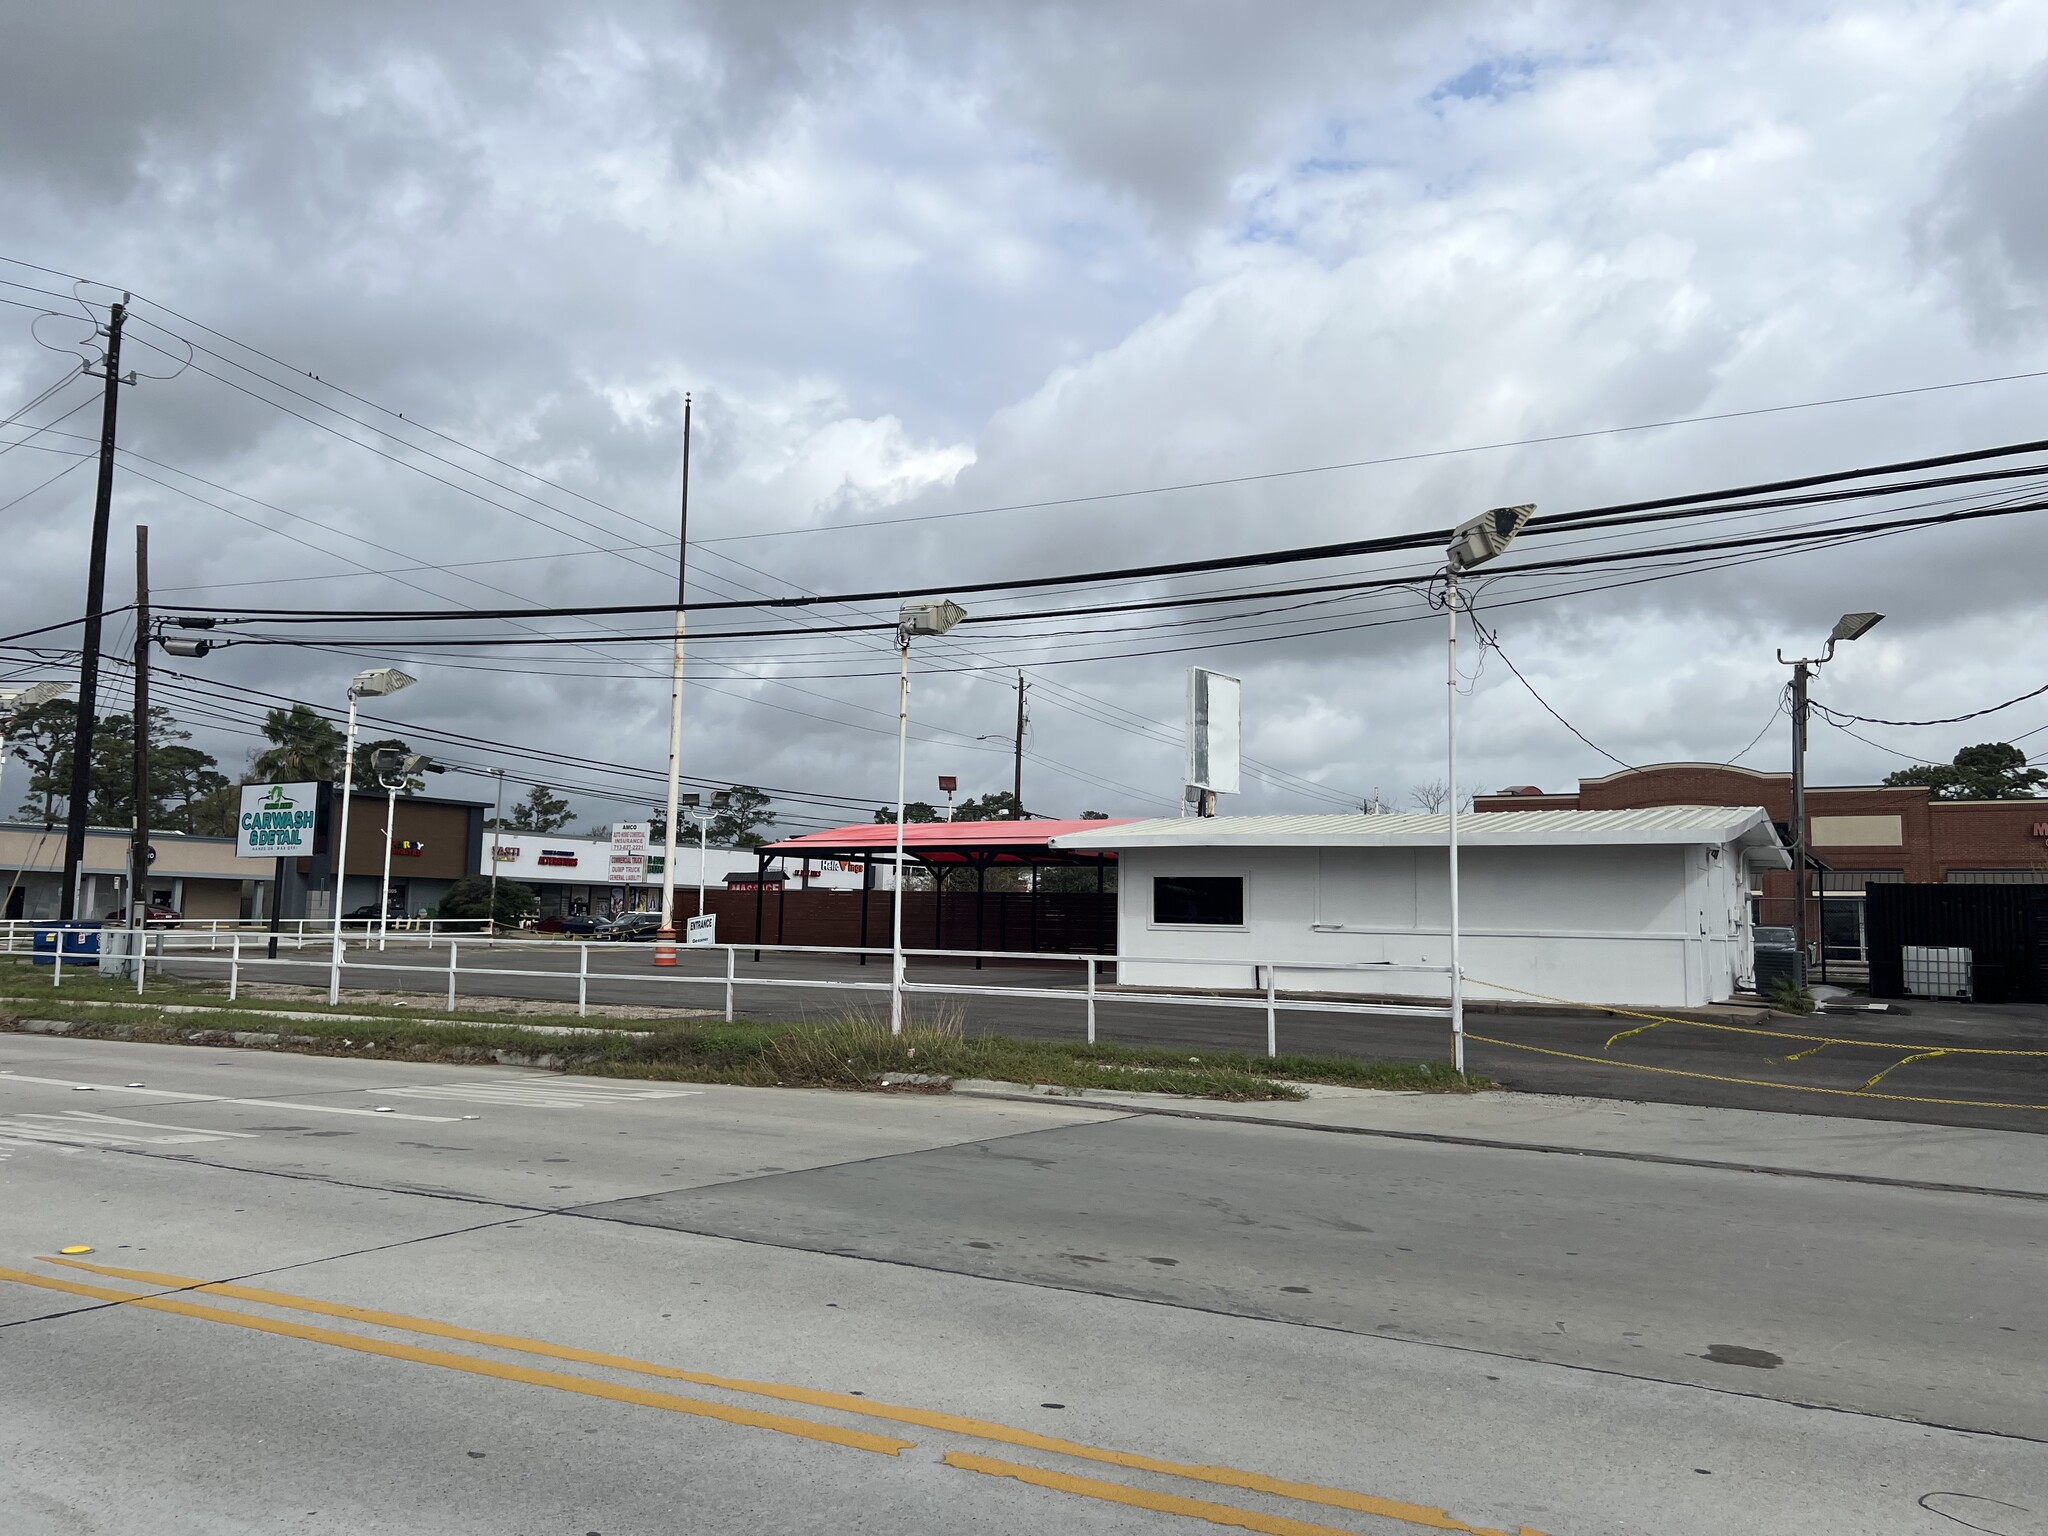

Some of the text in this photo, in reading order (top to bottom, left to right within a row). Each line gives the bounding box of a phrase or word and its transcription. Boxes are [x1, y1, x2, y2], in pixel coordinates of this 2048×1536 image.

[242, 811, 314, 830] CARWASH
[259, 830, 302, 845] DETAIL
[690, 918, 712, 931] ENTRANCE
